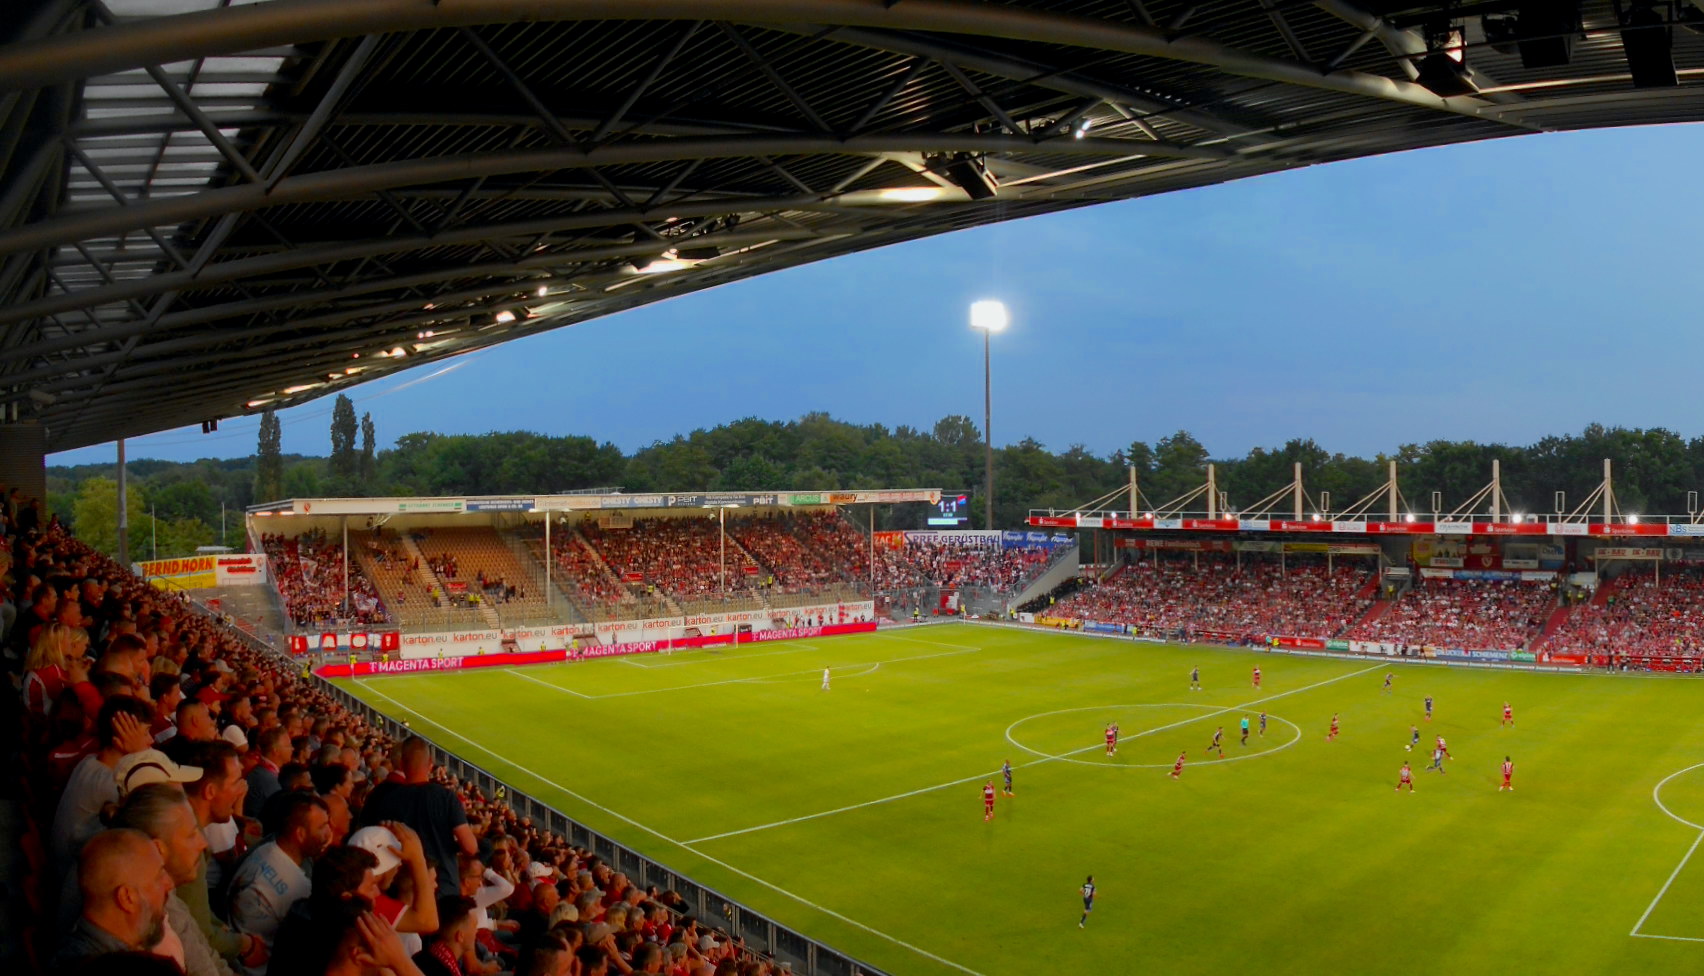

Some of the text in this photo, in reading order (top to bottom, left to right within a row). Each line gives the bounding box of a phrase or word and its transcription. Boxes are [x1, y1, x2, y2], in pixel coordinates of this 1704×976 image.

[938, 500, 957, 513] 1:1
[142, 560, 179, 577] BERND
[182, 558, 213, 573] HORN
[642, 618, 682, 629] karton.eu
[403, 634, 448, 645] karton.eu
[453, 631, 498, 642] karton.eu
[759, 629, 797, 641] MAGENTA
[798, 626, 823, 637] SPORT
[626, 641, 657, 653] SPORT
[379, 659, 430, 672] MAGENTA
[431, 657, 464, 669] SPORT
